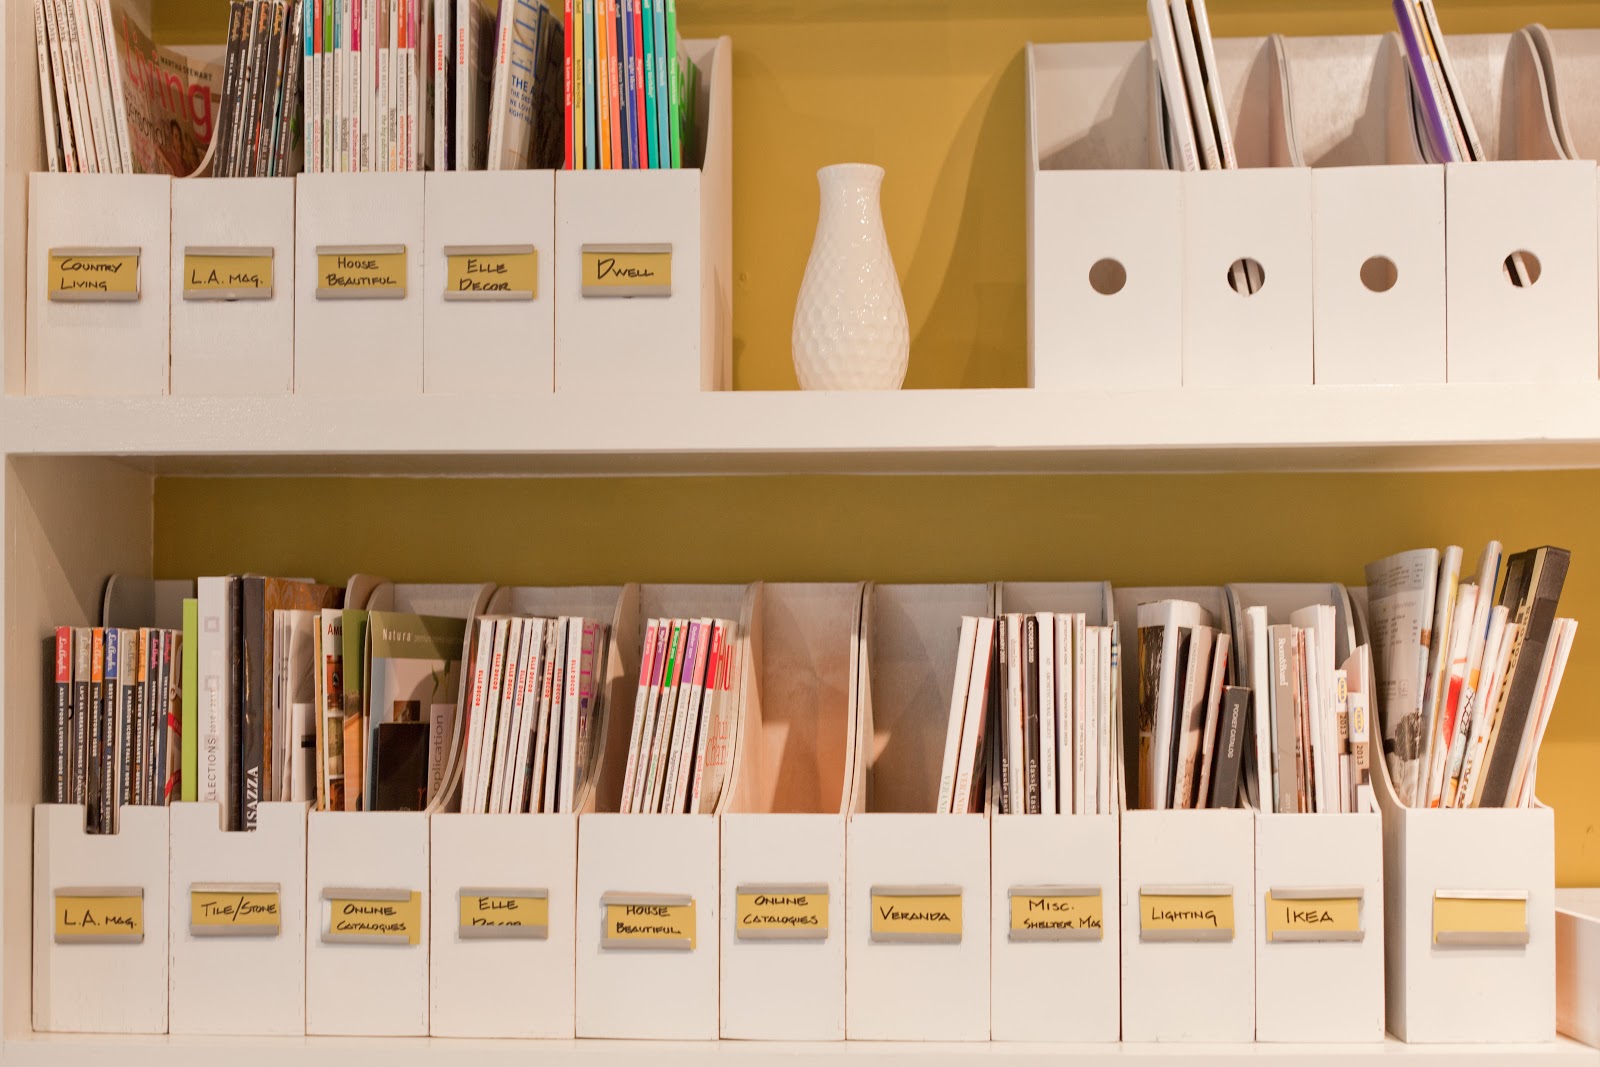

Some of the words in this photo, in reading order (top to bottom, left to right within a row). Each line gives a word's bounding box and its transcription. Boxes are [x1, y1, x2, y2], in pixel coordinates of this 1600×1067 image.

[123, 16, 213, 144] Living
[512, 74, 528, 92] THE
[466, 258, 508, 274] ELLE
[60, 277, 108, 291] LIVING
[191, 269, 224, 285] L.A.
[325, 273, 398, 287] BEAUTIFUL
[382, 628, 411, 642] Natura
[1278, 637, 1289, 687] Room&Board
[1231, 703, 1240, 729] POCKET
[1227, 729, 1237, 759] CATALOG
[1029, 759, 1037, 792] classic
[246, 766, 259, 832] ISAZZA
[343, 903, 397, 916] ONLINE
[478, 896, 519, 910] ELLE
[754, 895, 809, 907] ONLINE
[64, 909, 100, 928] L.A.
[879, 905, 951, 922] VERANDA
[1151, 906, 1218, 927] LIGHTING
[1286, 906, 1335, 924] IKEA
[616, 921, 681, 935] BEAUTIFUL
